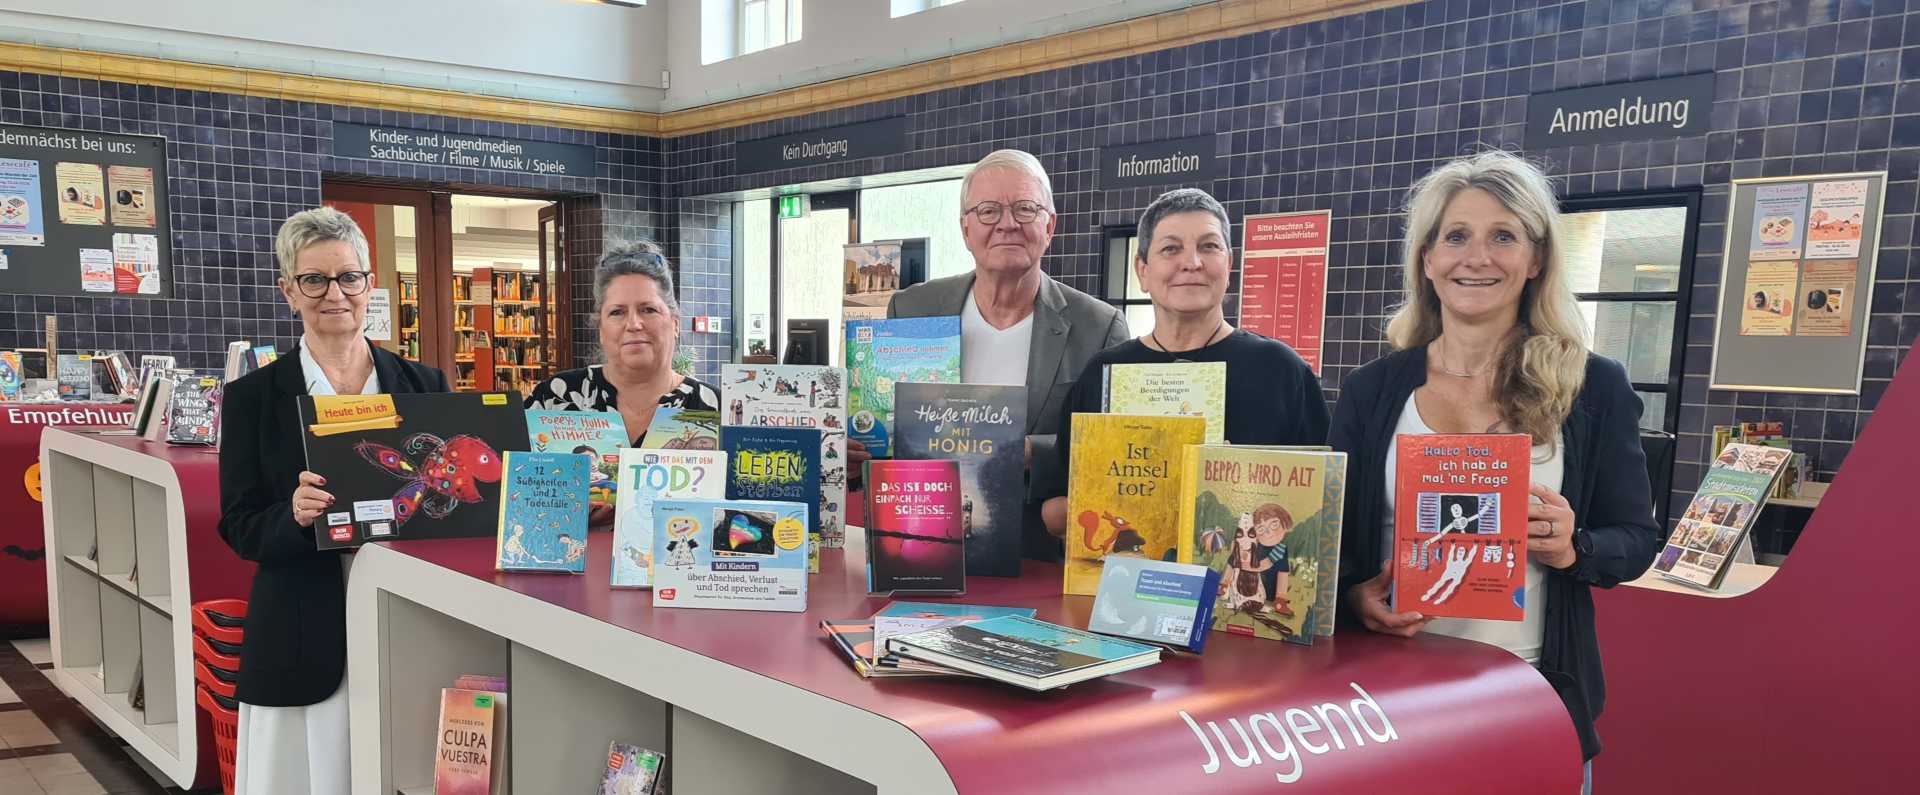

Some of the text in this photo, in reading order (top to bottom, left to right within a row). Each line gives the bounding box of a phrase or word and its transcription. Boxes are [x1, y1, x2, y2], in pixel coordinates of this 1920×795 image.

[1548, 96, 1690, 134] Anmeldung
[82, 136, 103, 152] bei
[108, 142, 137, 154] uns:
[370, 129, 522, 155] Kinder- und Jugendmedien
[783, 138, 848, 160] Kein Durchgang
[370, 145, 438, 163] Sachbücher
[450, 150, 480, 166] Filme
[490, 156, 523, 170] Musik
[533, 160, 566, 175] Spiele
[1117, 151, 1200, 178] Information
[1257, 221, 1315, 232] Bitte beachten Sie
[1273, 231, 1319, 240] Ausleihfristen
[177, 399, 208, 407] WINGS
[325, 403, 388, 418] Heute bin ich
[181, 408, 201, 416] THAT
[914, 404, 1013, 433] Heiße Milch
[951, 427, 973, 437] MIT
[928, 438, 993, 455] HONIG
[1127, 442, 1150, 460] Ist
[661, 455, 670, 465] IST
[671, 456, 685, 464] DAS
[685, 456, 698, 464] MIT
[699, 457, 714, 465] DEM
[738, 454, 802, 478] LEBEN
[1439, 459, 1508, 471] ich hab da
[534, 466, 545, 476] 12
[1106, 460, 1168, 479] Amsel
[1204, 459, 1316, 488] BEPPO WIRD ALT
[516, 476, 568, 489] Süßigkeiten
[628, 464, 706, 493] TOD?
[1422, 473, 1445, 484] mal
[1471, 473, 1509, 488] Frage
[533, 488, 550, 498] und
[903, 482, 920, 492] IST
[924, 482, 953, 492] DOCH
[1117, 480, 1156, 497] tot?
[524, 497, 569, 509] Todesfälle
[875, 494, 912, 503] EINFACH
[715, 562, 757, 571] Mit Kindern
[687, 573, 706, 582] über
[748, 575, 778, 584] Verlust
[696, 584, 769, 594] und Tod sprechen
[444, 729, 487, 750] CULPA
[1178, 682, 1399, 784] Jugend
[441, 748, 488, 766] VUESTRA
